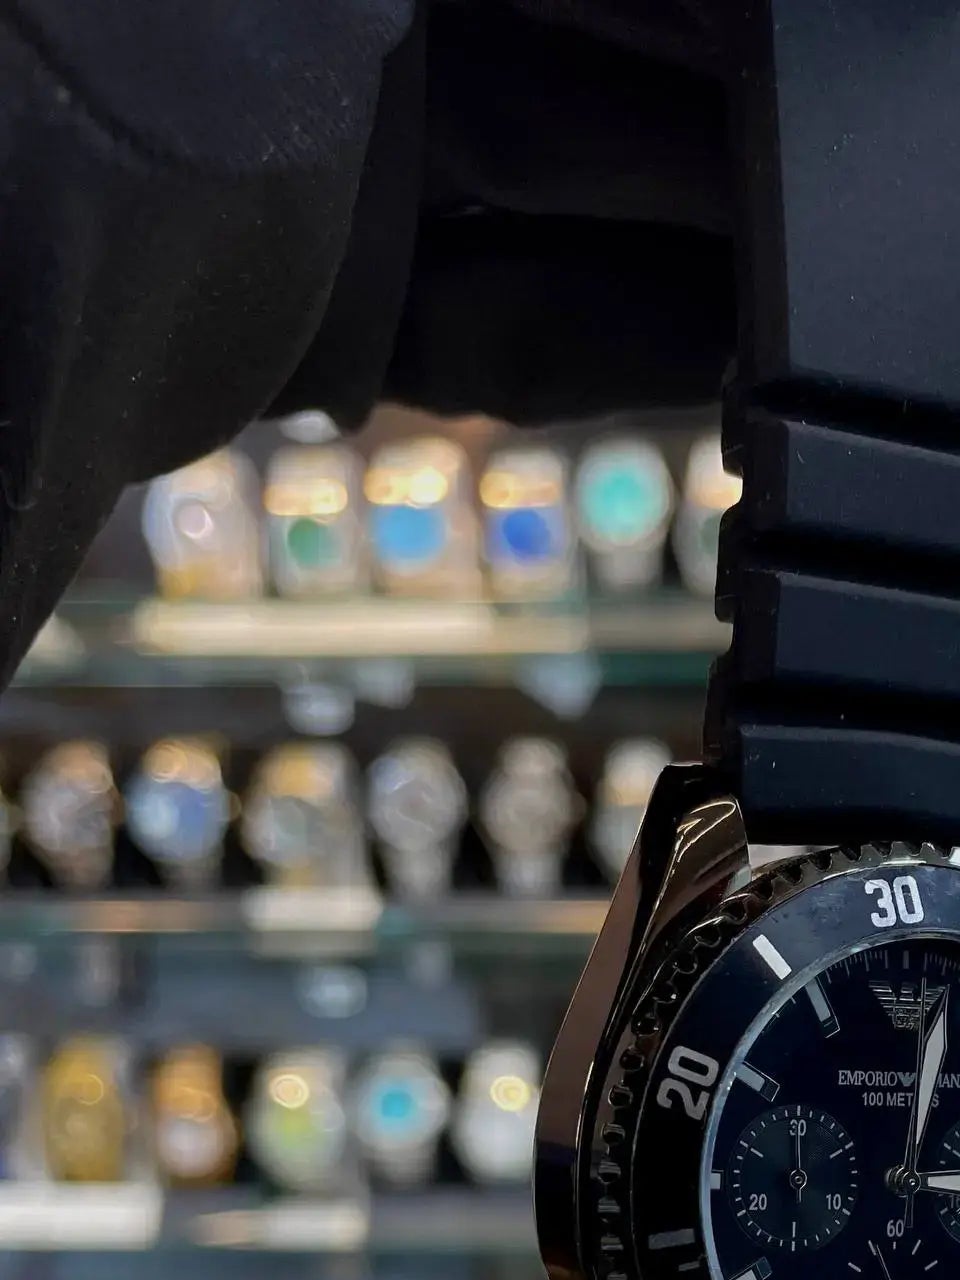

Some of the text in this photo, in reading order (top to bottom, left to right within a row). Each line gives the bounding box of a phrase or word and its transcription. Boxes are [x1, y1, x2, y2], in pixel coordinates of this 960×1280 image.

[864, 875, 924, 927] 30
[656, 1045, 719, 1120] 20
[838, 1070, 898, 1087] EMPORIO
[862, 1092, 939, 1108] 100 METS
[789, 1119, 807, 1136] 30
[749, 1193, 767, 1211] 20
[826, 1193, 841, 1210] 10
[886, 1219, 904, 1238] 60
